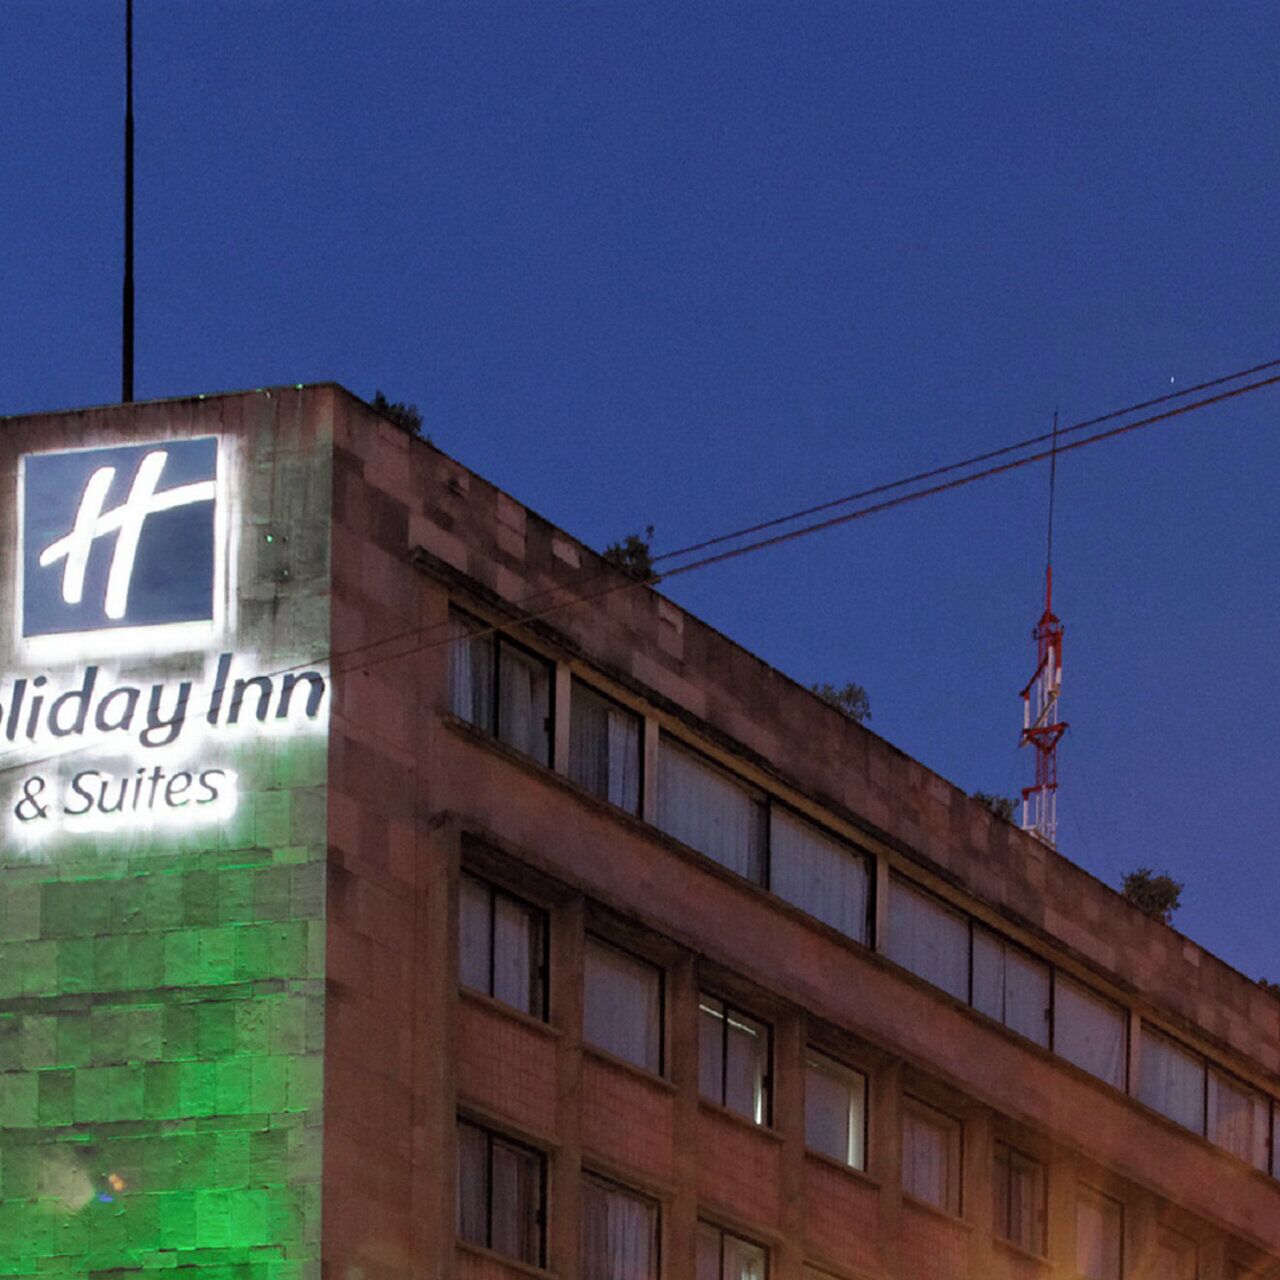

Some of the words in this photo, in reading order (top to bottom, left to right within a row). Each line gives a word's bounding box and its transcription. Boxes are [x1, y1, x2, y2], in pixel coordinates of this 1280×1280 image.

[206, 652, 326, 726] Inn
[14, 775, 51, 822] &
[63, 765, 227, 817] Suites
